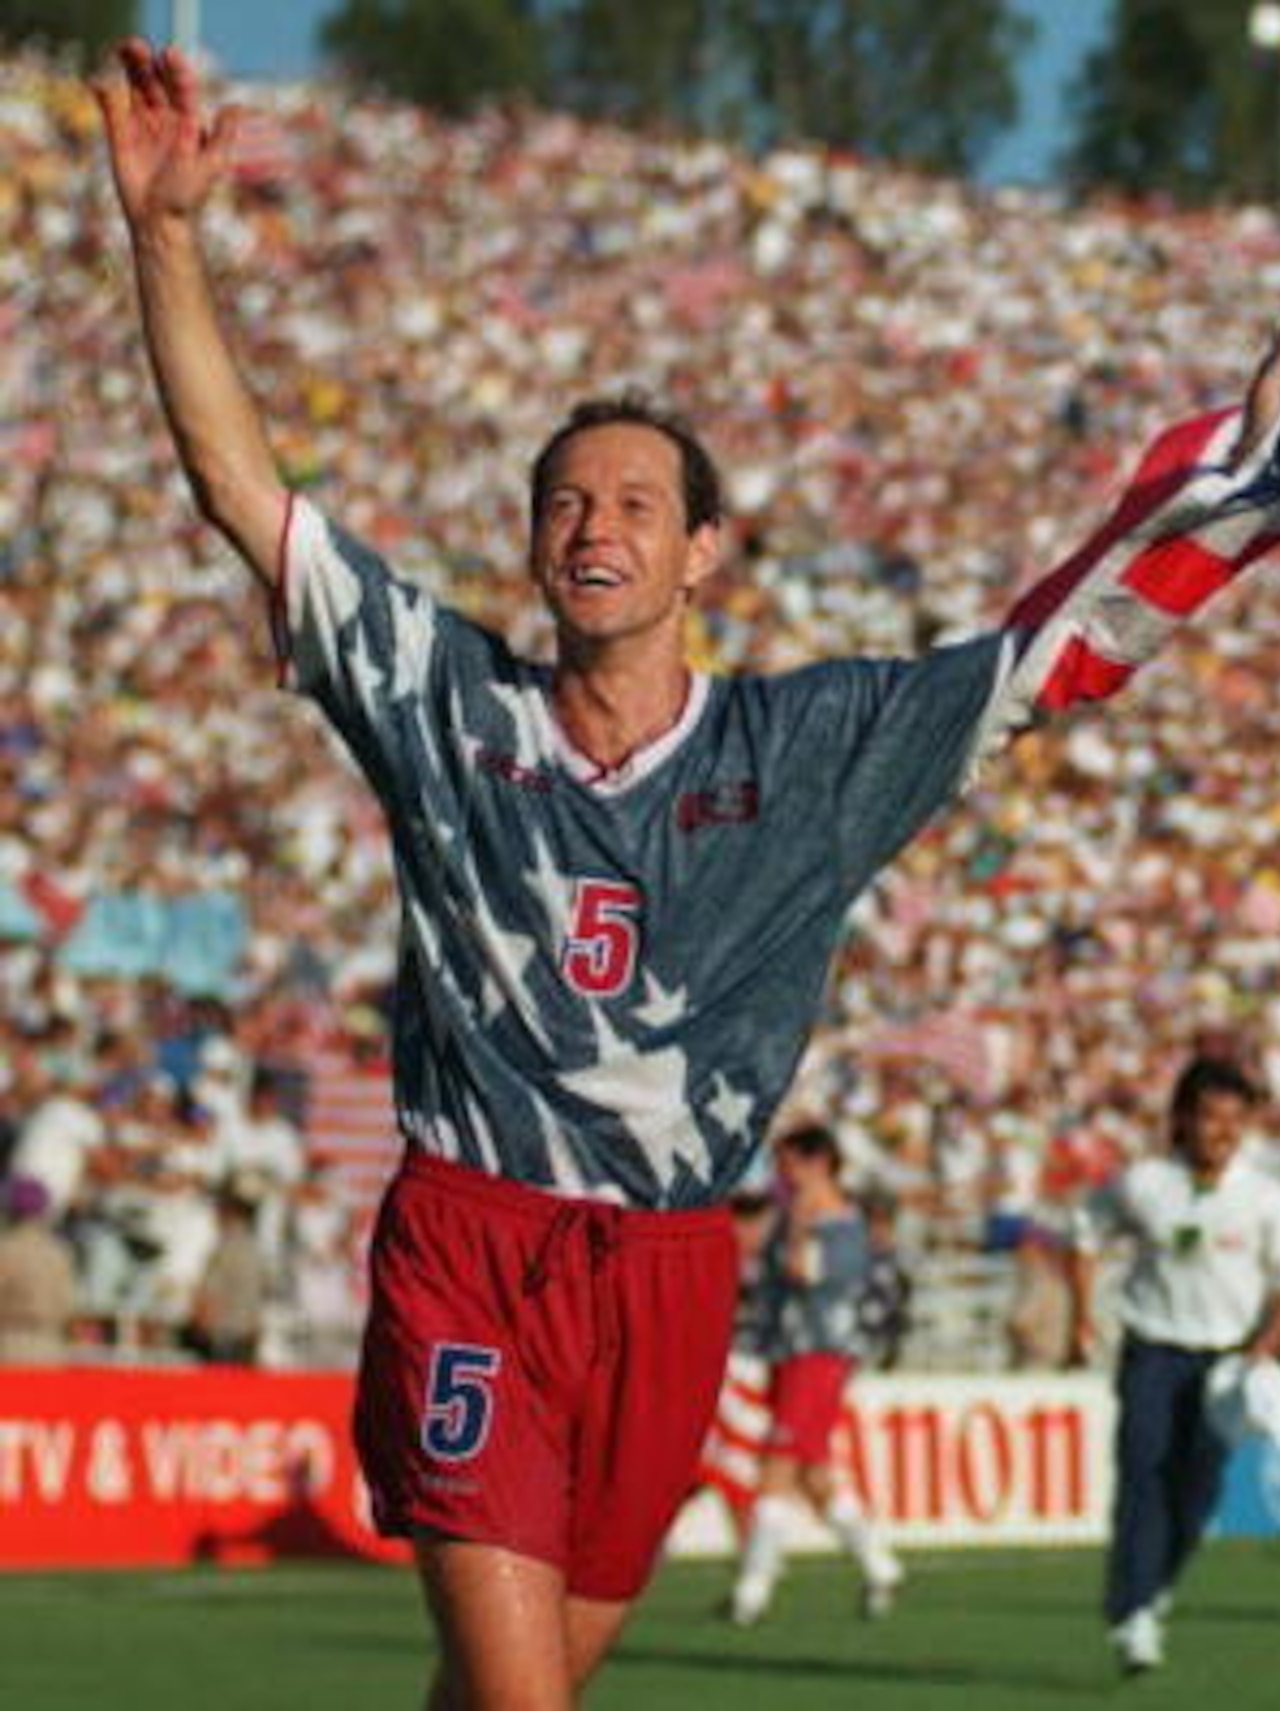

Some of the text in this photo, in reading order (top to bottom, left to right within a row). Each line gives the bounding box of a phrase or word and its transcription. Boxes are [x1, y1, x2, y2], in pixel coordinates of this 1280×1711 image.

[563, 879, 644, 997] 5
[0, 1416, 335, 1504] TV & VIDEO
[420, 1343, 502, 1463] 5
